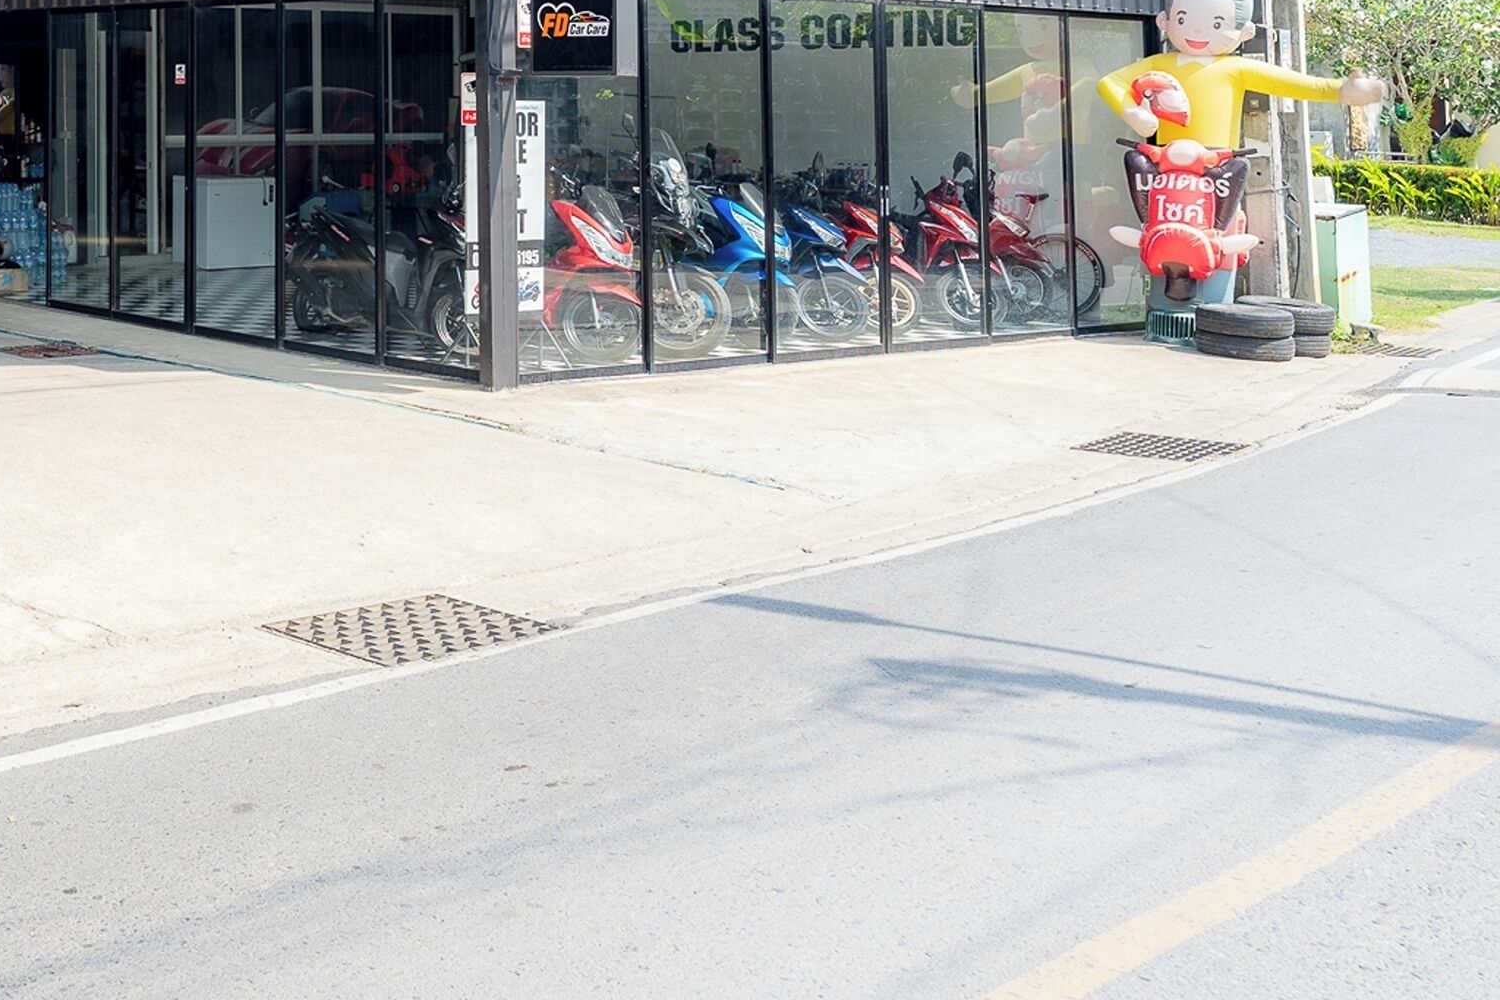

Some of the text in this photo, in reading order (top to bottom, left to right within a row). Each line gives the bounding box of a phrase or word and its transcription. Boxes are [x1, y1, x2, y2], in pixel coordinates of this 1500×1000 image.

[542, 13, 607, 37] FD Car Care
[800, 8, 977, 50] COATING
[516, 111, 538, 137] OR
[1135, 172, 1233, 198] มอเตอร์
[1156, 195, 1206, 224] ไซค์
